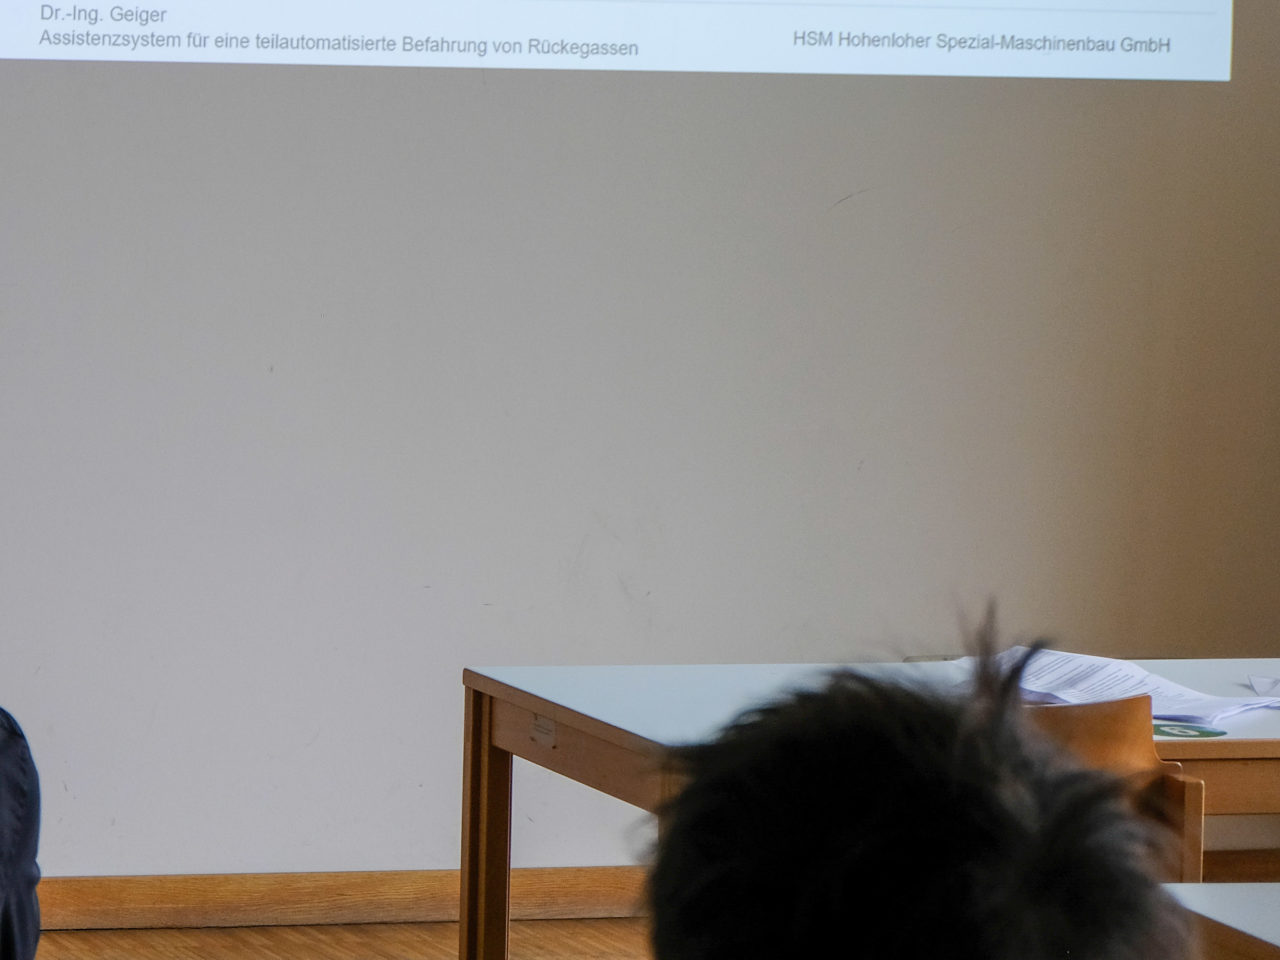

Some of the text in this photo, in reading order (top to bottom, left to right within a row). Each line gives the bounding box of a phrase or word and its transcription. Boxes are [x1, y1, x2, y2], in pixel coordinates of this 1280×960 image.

[41, 4, 167, 27] Dr.-Ing. Geiger
[39, 29, 638, 59] Assistenzsystem für eine teilautomatisierte Befahrung von Rückegassen
[794, 30, 1171, 53] HSM Hohenloher Spezial-Maschinenbau GmbH
